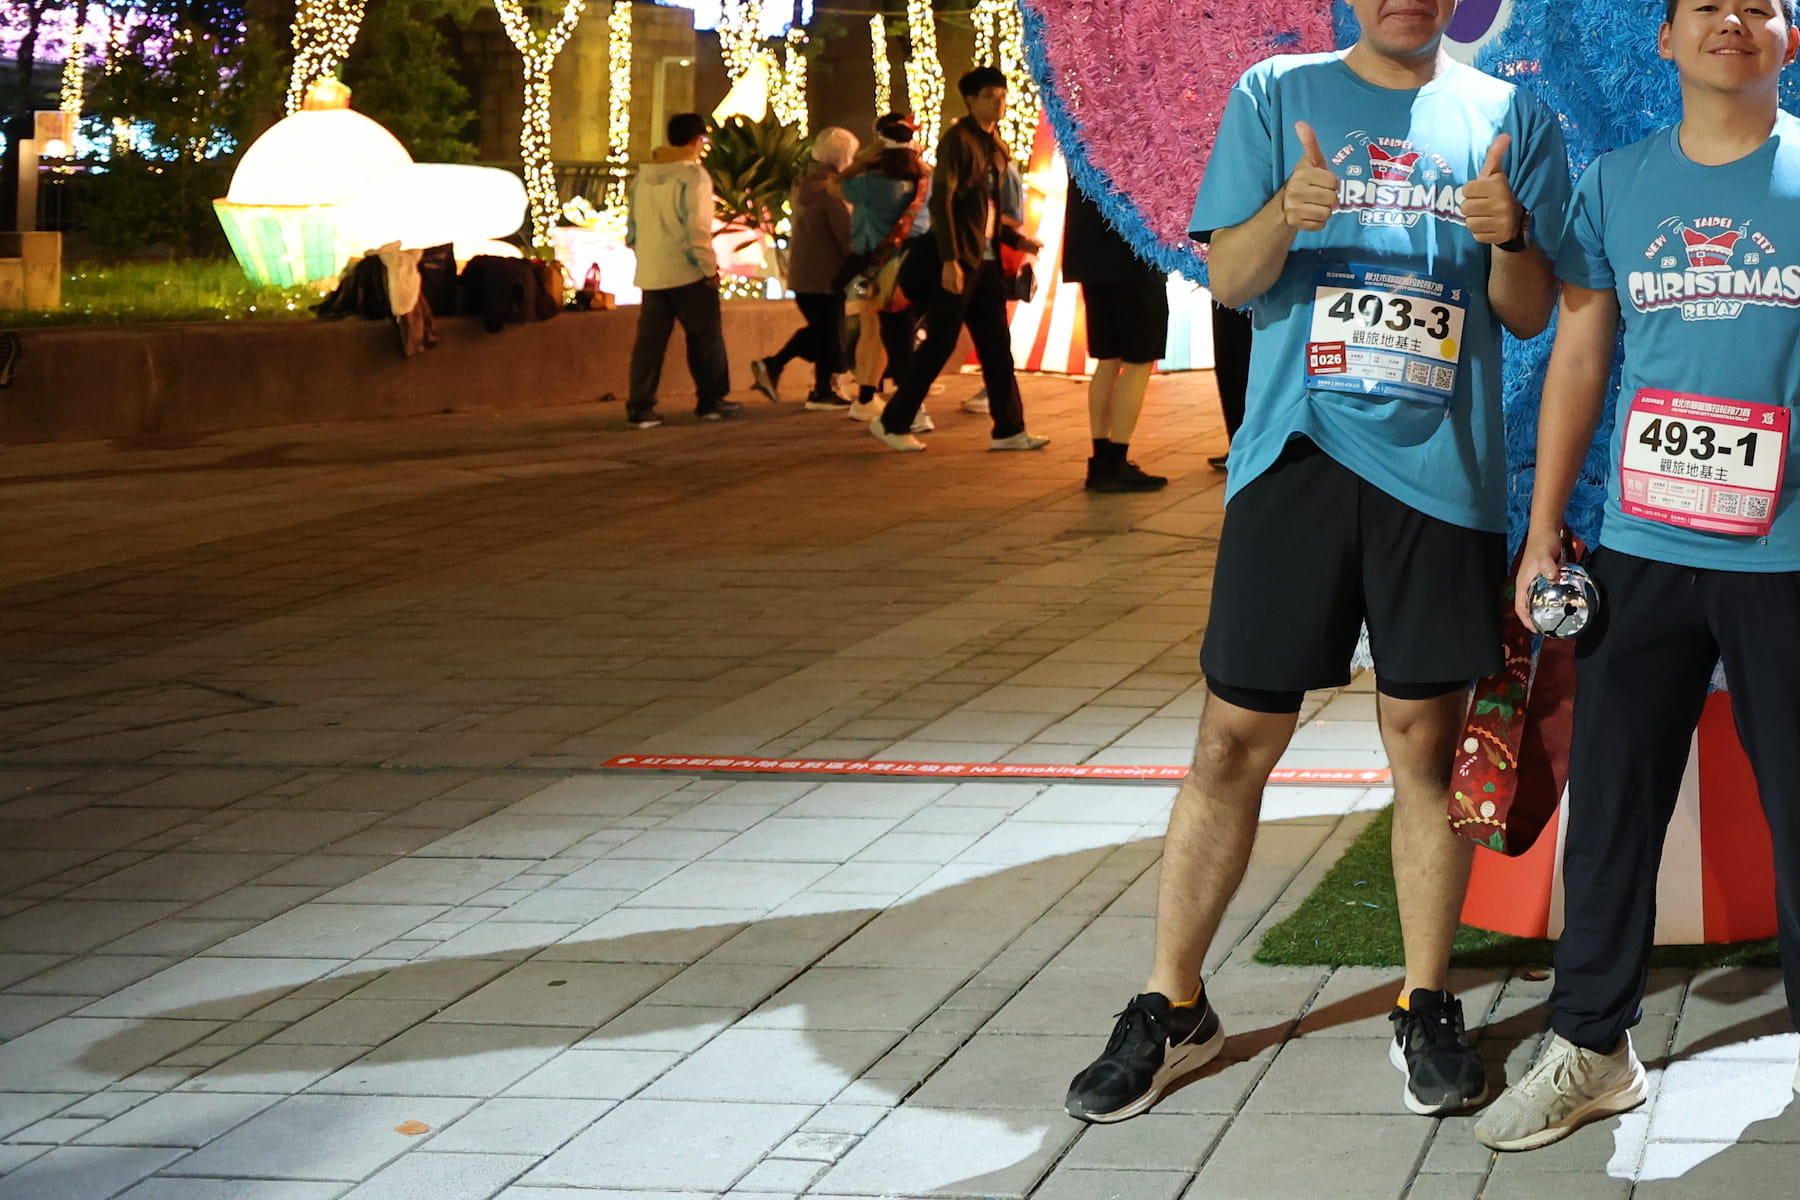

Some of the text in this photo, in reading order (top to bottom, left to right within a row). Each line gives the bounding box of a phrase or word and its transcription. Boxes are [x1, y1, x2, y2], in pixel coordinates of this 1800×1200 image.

[1331, 144, 1355, 166] NEW
[1377, 137, 1413, 150] TAIPEI
[1337, 179, 1466, 217] HRISTMAS
[1361, 211, 1417, 225] RELAY
[1645, 216, 1776, 259] NEW TAIPEI CITY
[1661, 253, 1760, 268] 20 25
[1328, 292, 1450, 340] 493-3
[1683, 301, 1741, 318] RELAY
[1352, 329, 1423, 353] 觀旅地基主
[1639, 418, 1758, 467] 493-1
[1660, 457, 1728, 482] 觀旅地基主
[970, 766, 997, 774] No
[1001, 766, 1088, 776] Smoking
[1092, 767, 1156, 777] Except
[1299, 770, 1354, 779] Areas
